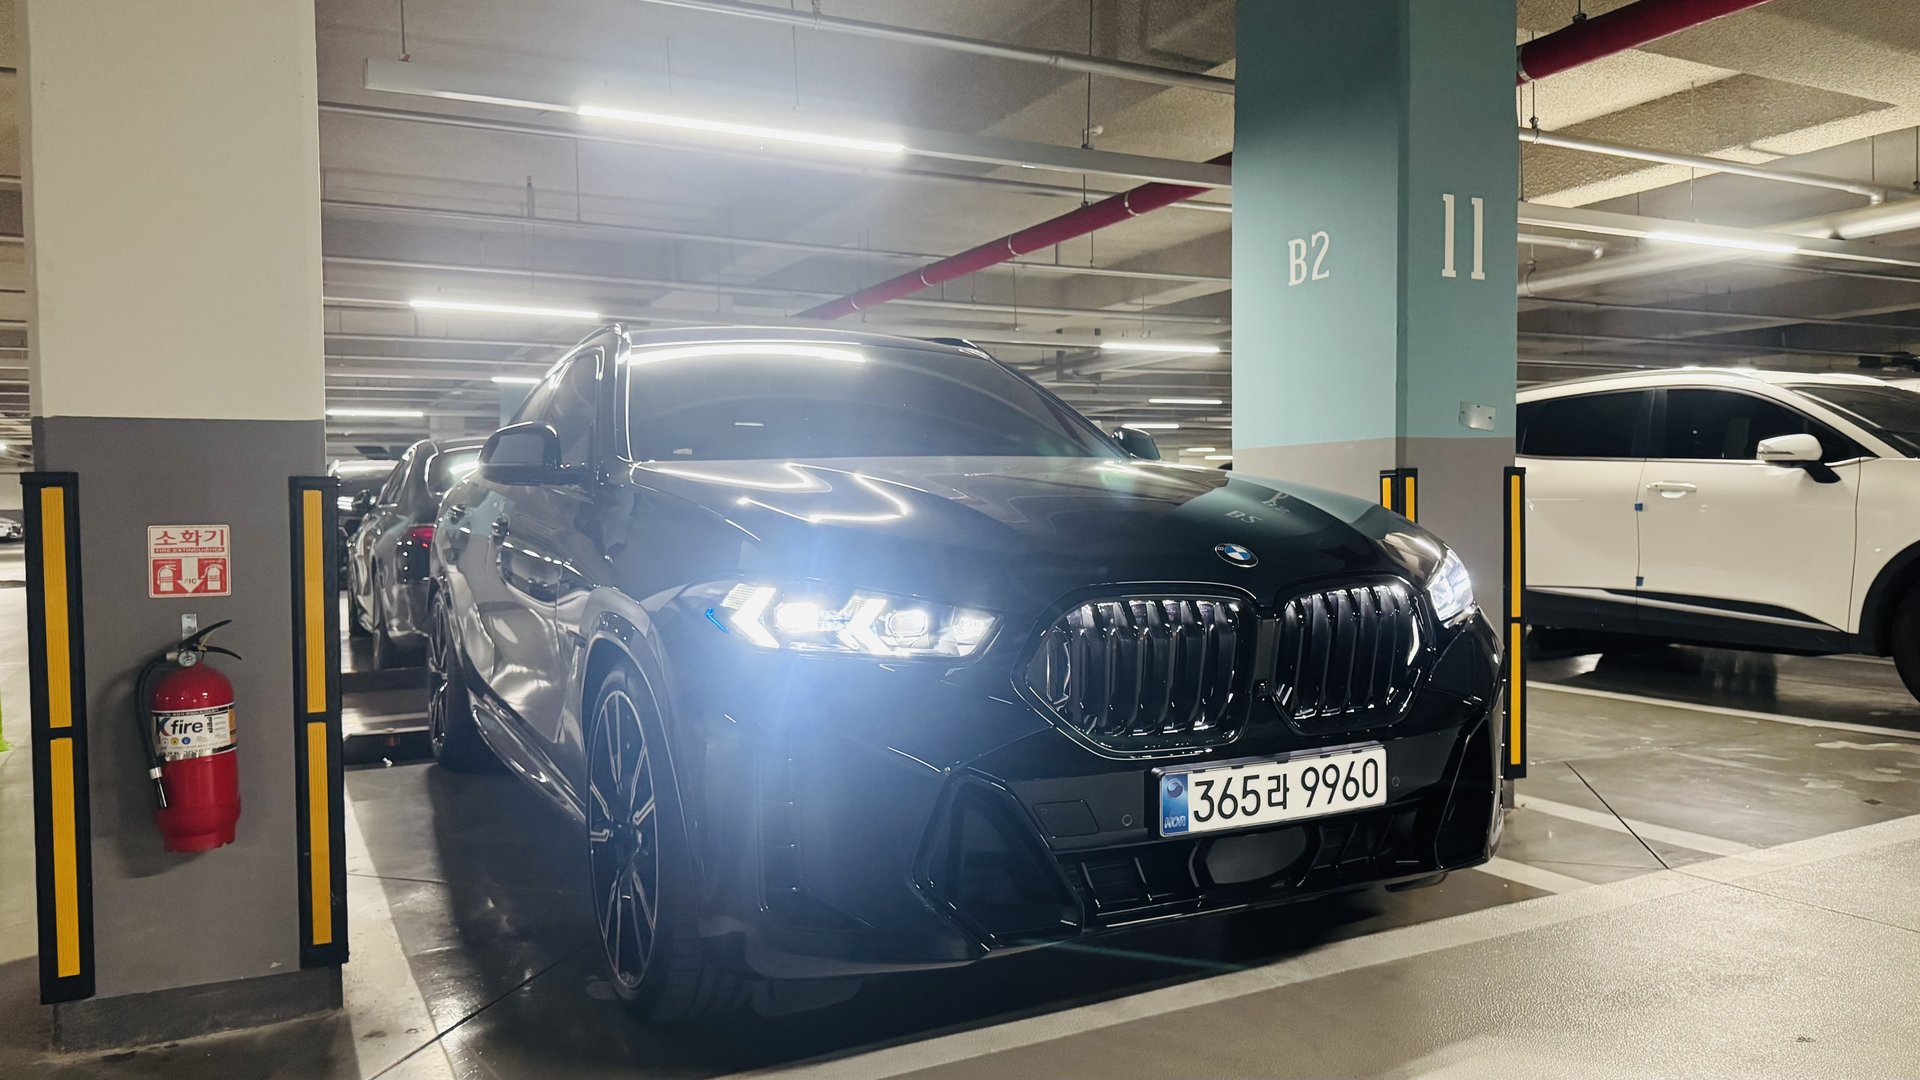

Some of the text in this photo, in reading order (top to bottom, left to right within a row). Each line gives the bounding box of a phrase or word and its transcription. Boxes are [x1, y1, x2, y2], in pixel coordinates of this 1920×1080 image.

[1287, 230, 1330, 287] B2
[1441, 193, 1486, 281] 11
[154, 529, 225, 546] 소화기
[1193, 758, 1379, 822] 365라 9960
[1163, 815, 1187, 829] KOR
